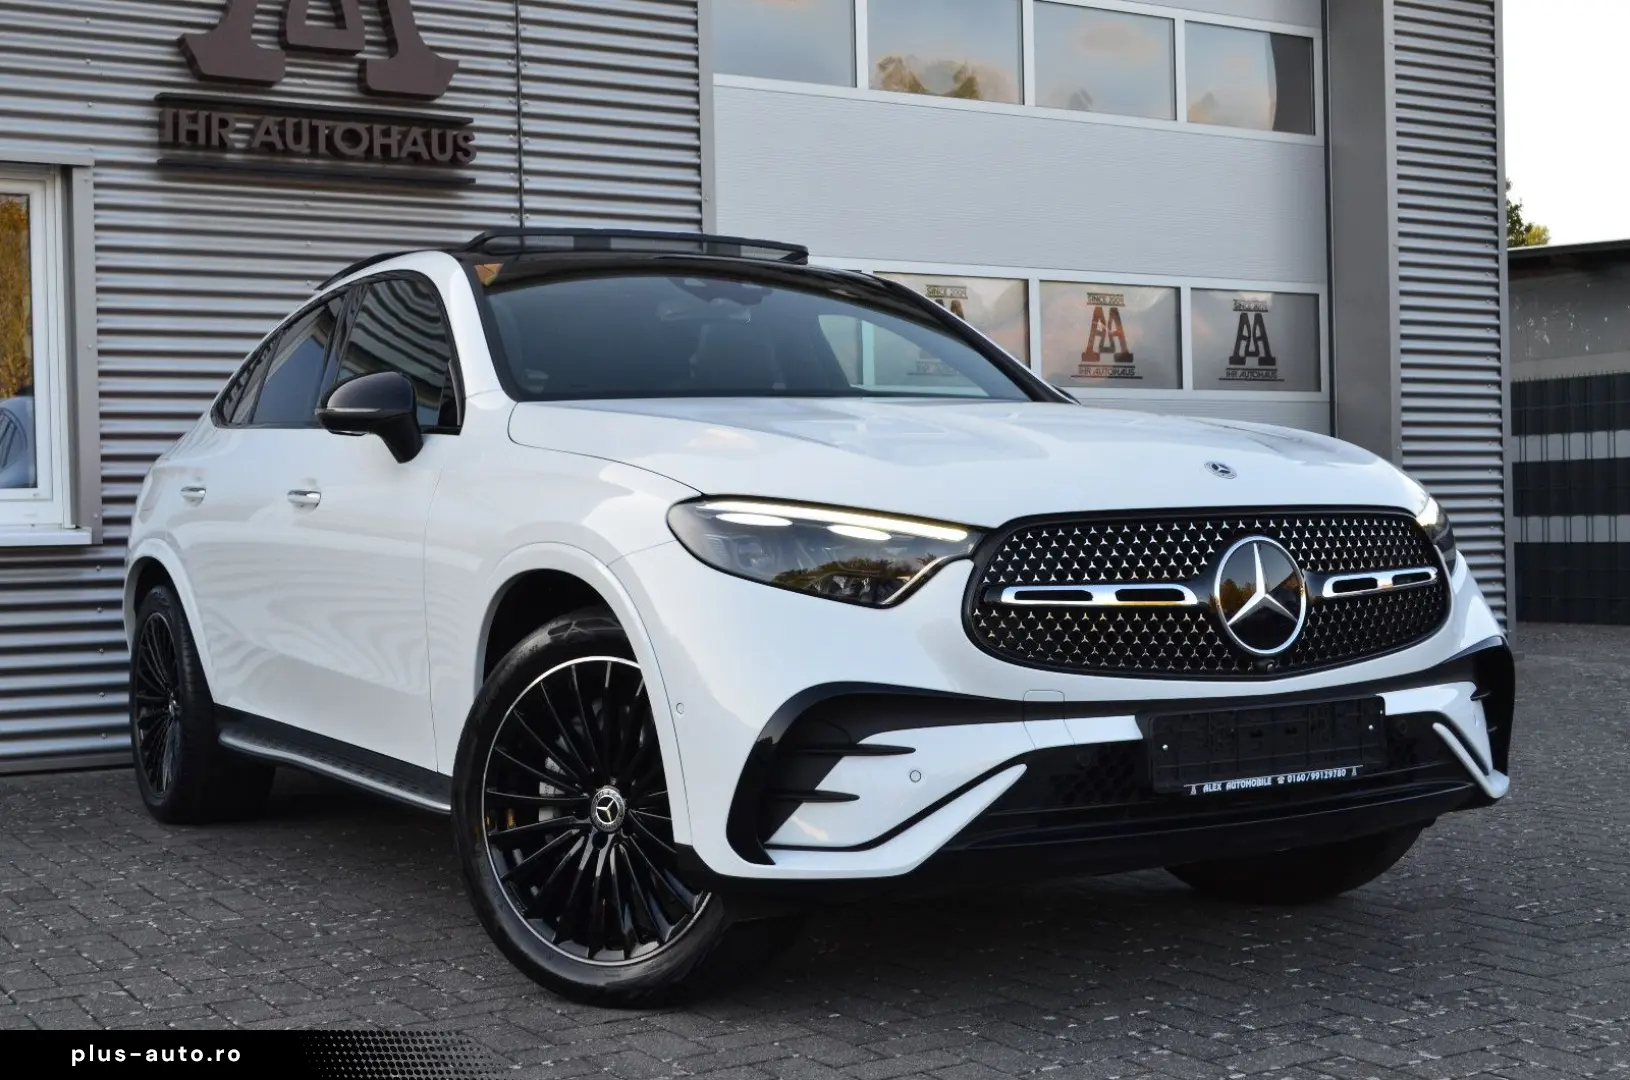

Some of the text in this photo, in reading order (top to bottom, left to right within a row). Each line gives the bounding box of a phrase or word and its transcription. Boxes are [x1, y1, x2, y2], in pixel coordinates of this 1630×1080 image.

[159, 108, 477, 164] IHR AUTOHAUS
[926, 286, 946, 297] SINCE
[1087, 294, 1107, 304] SINCE
[1078, 367, 1136, 377] IHR AUTOHAUS
[1225, 370, 1278, 379] IHR AUTOHAUS
[1203, 782, 1222, 793] ALEX
[1226, 777, 1272, 791] AUTOMOBILE
